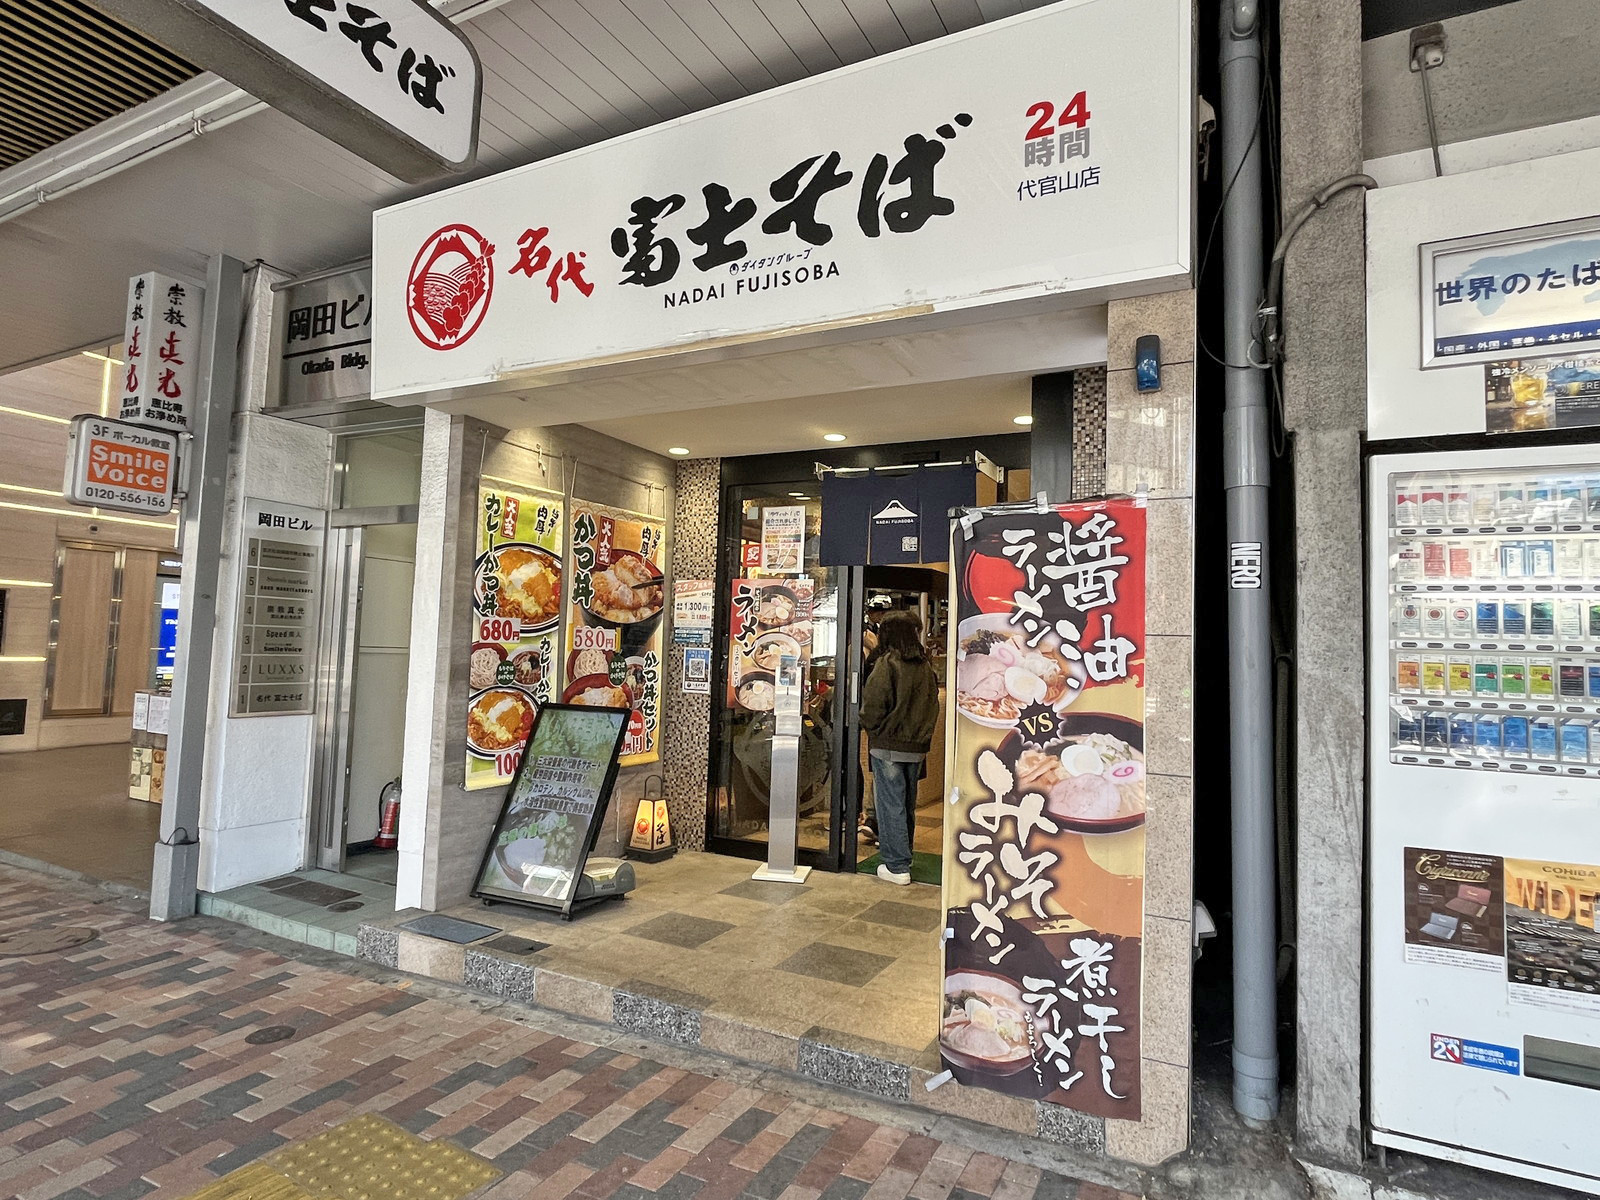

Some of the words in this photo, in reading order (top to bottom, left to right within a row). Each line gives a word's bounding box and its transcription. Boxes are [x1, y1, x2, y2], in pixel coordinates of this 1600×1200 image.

[1025, 91, 1091, 141] 24
[1025, 128, 1090, 168] 時間
[1017, 166, 1101, 201] 代官山店
[508, 227, 595, 303] 名代
[610, 113, 974, 288] 富士そば
[741, 247, 813, 272] ダイタングループ
[664, 283, 725, 309] NADAI
[736, 261, 840, 296] FUJISOBA
[301, 357, 335, 375] Okada
[341, 352, 369, 370] Bldg.
[145, 409, 187, 426] お浄め所
[151, 398, 183, 412] 恵比寿
[92, 425, 109, 438] 3F
[113, 431, 170, 450] ボーカル教室
[92, 445, 167, 472] Smile
[92, 462, 165, 488] Voice
[85, 487, 166, 507] 0120-556-156
[258, 512, 313, 532] 岡田ビル
[481, 493, 501, 617] カレーかつ丼
[572, 513, 597, 608] かつ丼
[1231, 542, 1262, 589] NERO
[1001, 528, 1051, 648] ラーメン
[1042, 512, 1136, 690] 醤油
[266, 629, 287, 638] Speed
[480, 619, 520, 641] 680円
[733, 585, 757, 657] ラーメン
[574, 629, 614, 649] 580円
[242, 665, 248, 674] 2
[258, 664, 305, 675] LUXXS
[643, 650, 659, 752] かつ丼セット
[1022, 712, 1054, 735] VS
[656, 822, 667, 846] そば
[969, 749, 1059, 920] みそ
[1542, 865, 1597, 878] COHIBA
[959, 831, 1016, 964] ラーメン
[1061, 937, 1127, 1100] 煮干し
[1022, 975, 1084, 1091] ラーメン
[1432, 1036, 1460, 1046] UNDER
[1433, 1041, 1460, 1062] 20
